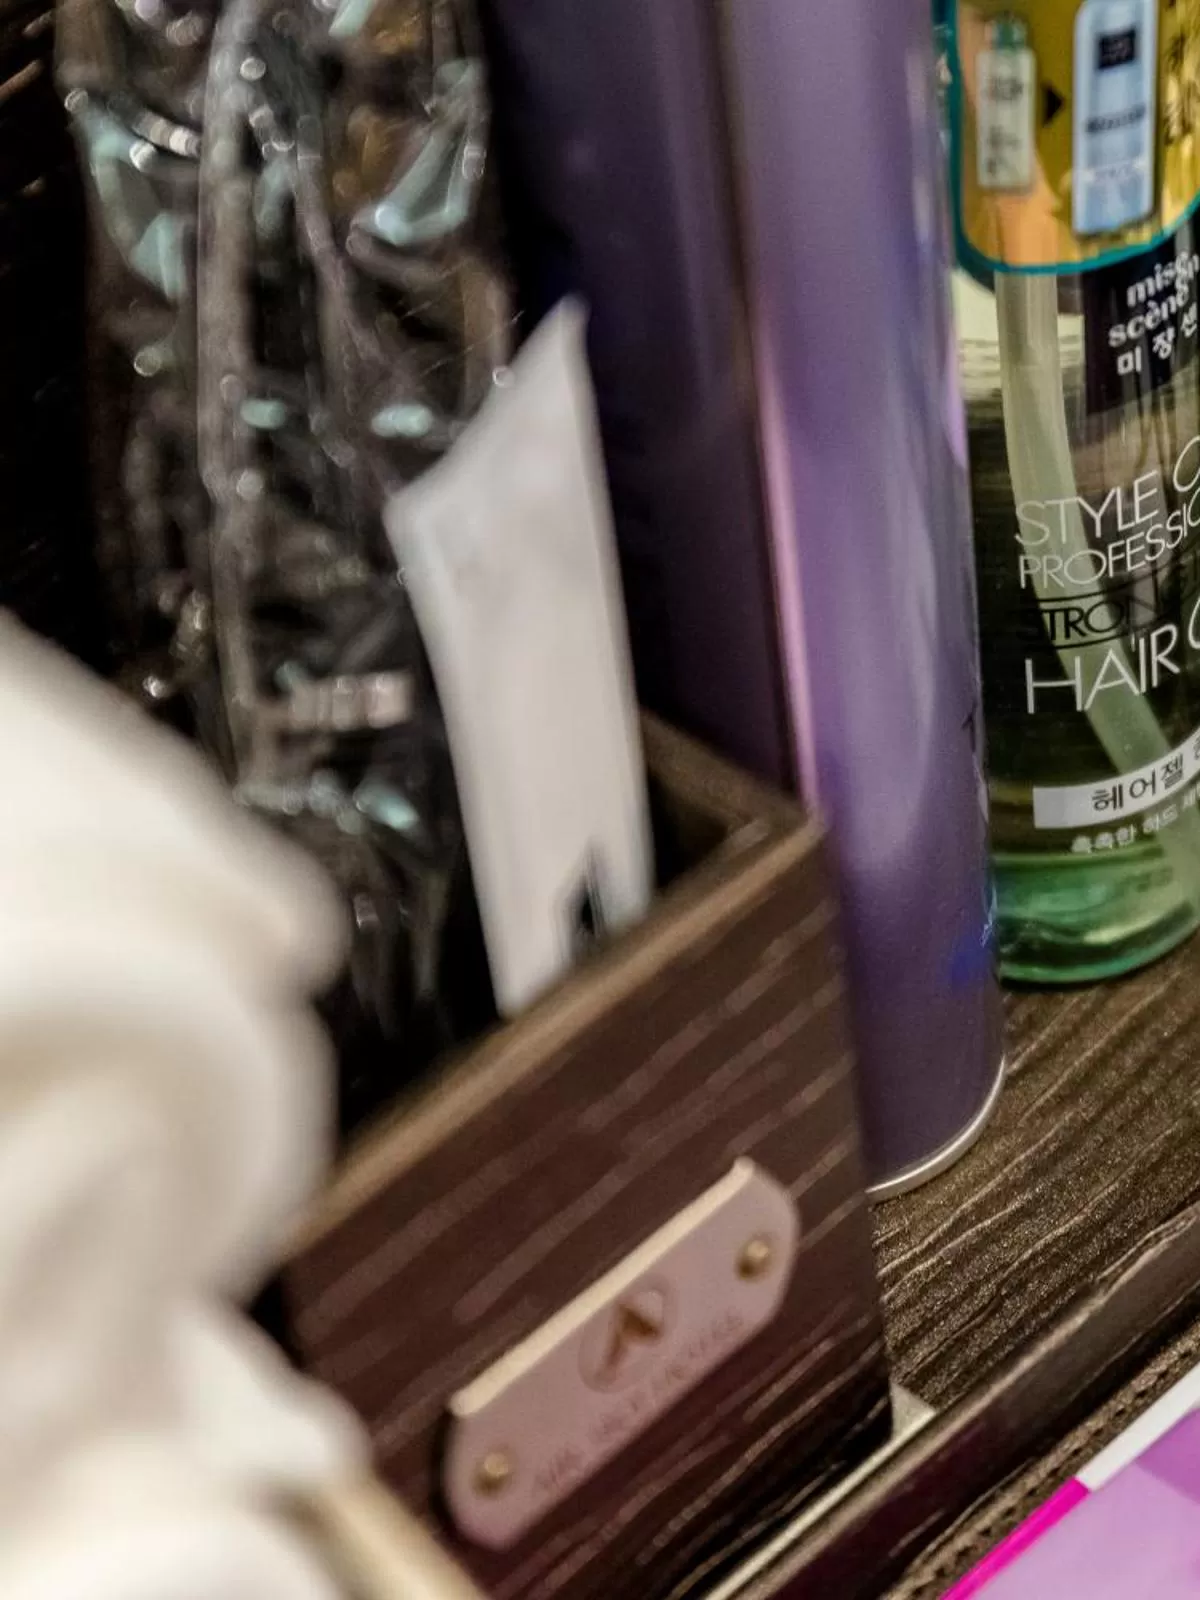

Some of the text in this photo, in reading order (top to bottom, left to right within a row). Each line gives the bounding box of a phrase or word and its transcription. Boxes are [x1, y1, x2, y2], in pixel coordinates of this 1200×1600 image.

[1117, 302, 1197, 376] 미장센
[1014, 469, 1159, 547] STYLE
[1025, 623, 1181, 714] HAIR
[1091, 753, 1184, 812] 헤어젤
